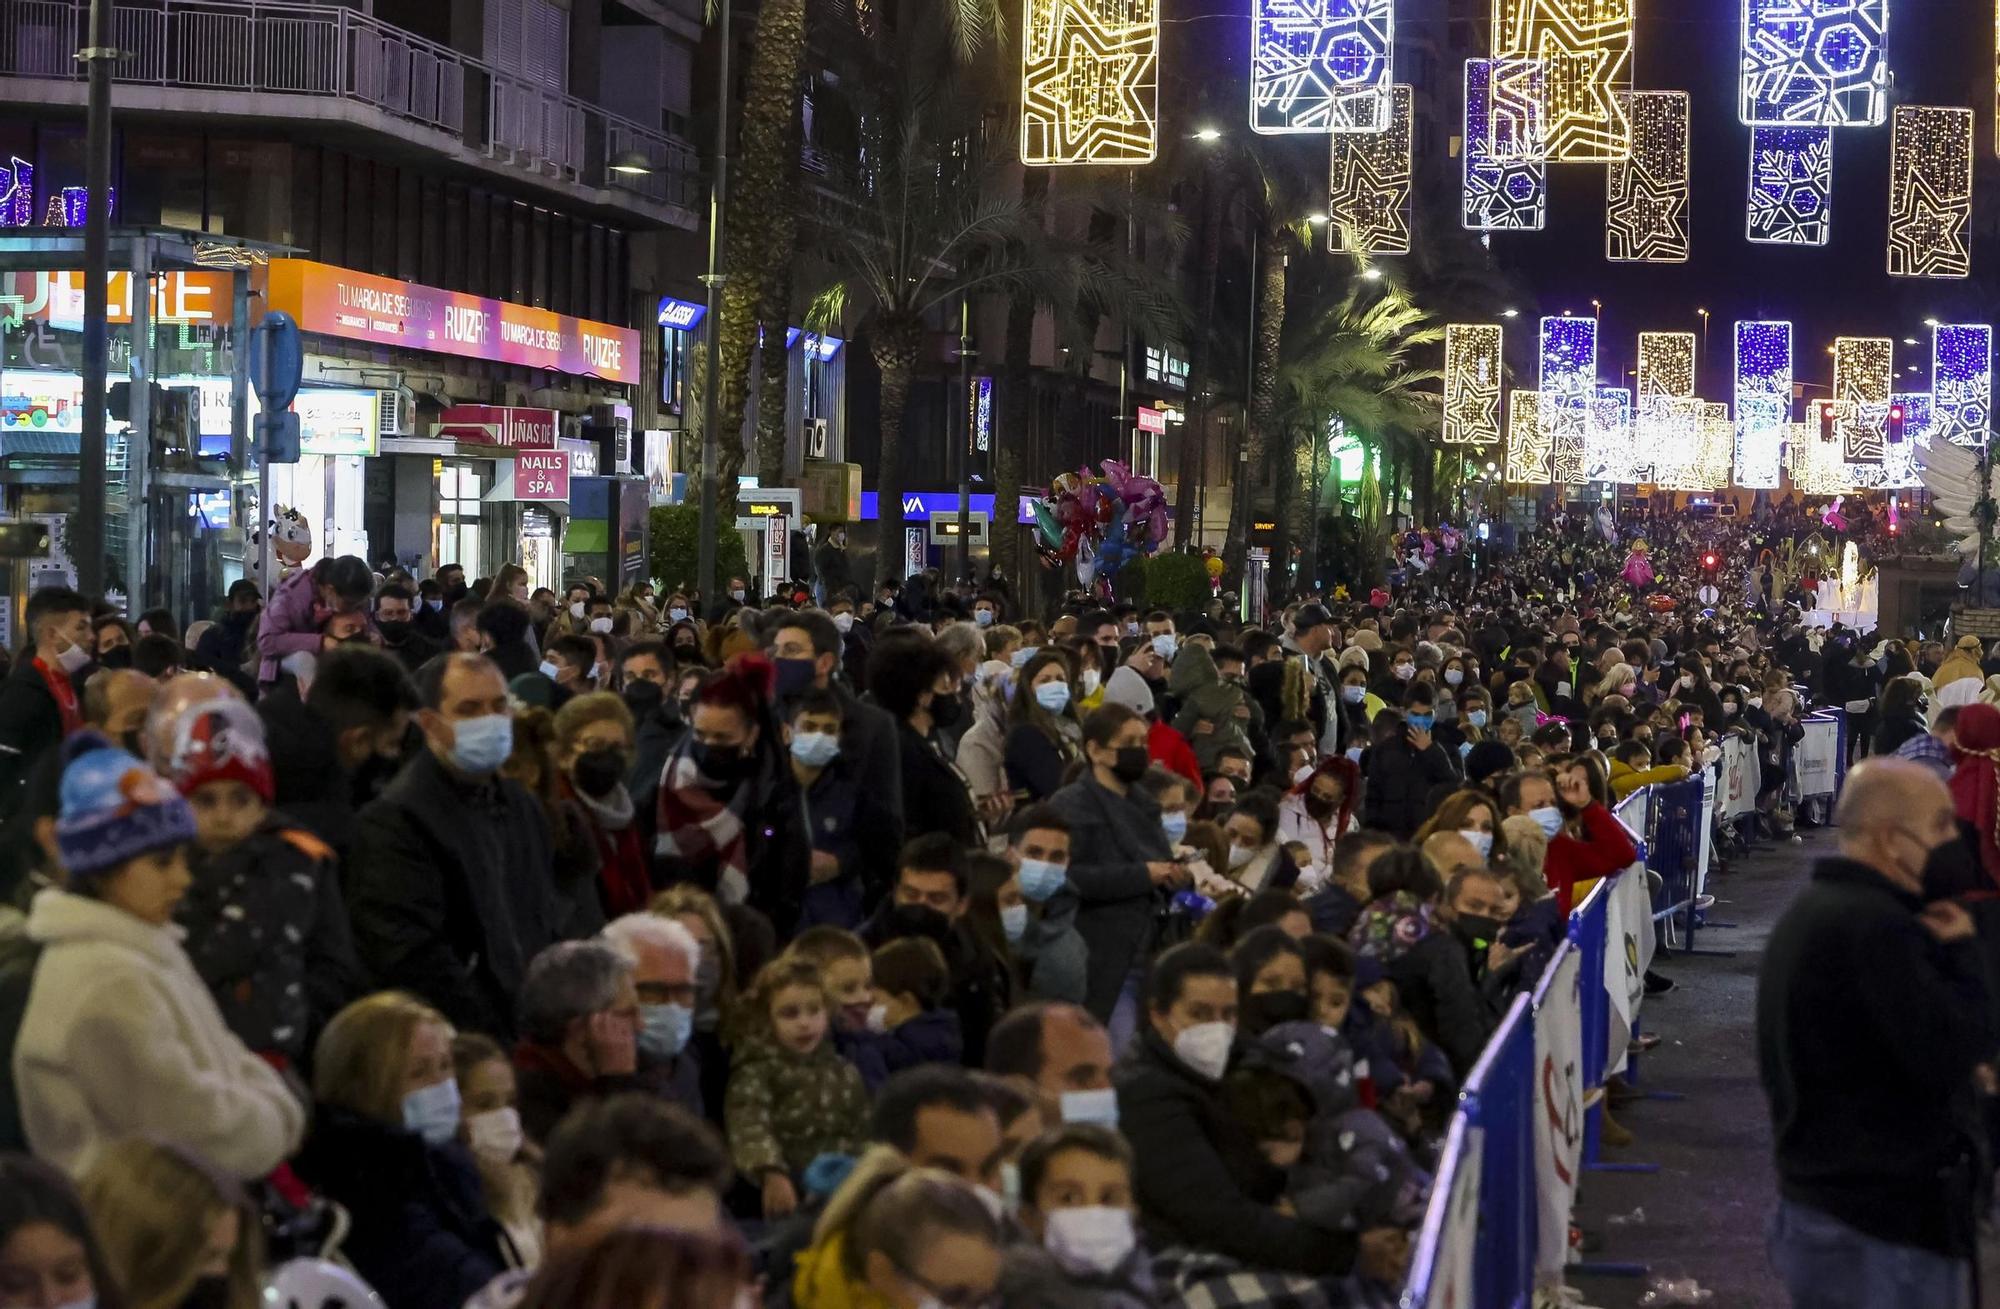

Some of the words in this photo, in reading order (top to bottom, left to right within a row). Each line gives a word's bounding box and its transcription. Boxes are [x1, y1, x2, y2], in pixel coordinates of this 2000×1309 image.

[337, 283, 349, 306] TU
[351, 286, 381, 312] MARCA
[382, 291, 394, 314] DE
[444, 305, 490, 345] RUIZRE
[500, 320, 510, 341] TU
[510, 323, 534, 346] MARCA
[535, 329, 545, 350] DE
[583, 333, 621, 371] RUIZRE
[510, 418, 540, 443] UÑAS
[541, 424, 551, 444] DE
[521, 456, 562, 470] NAILS
[537, 470, 546, 480] &
[528, 480, 554, 494] SPA
